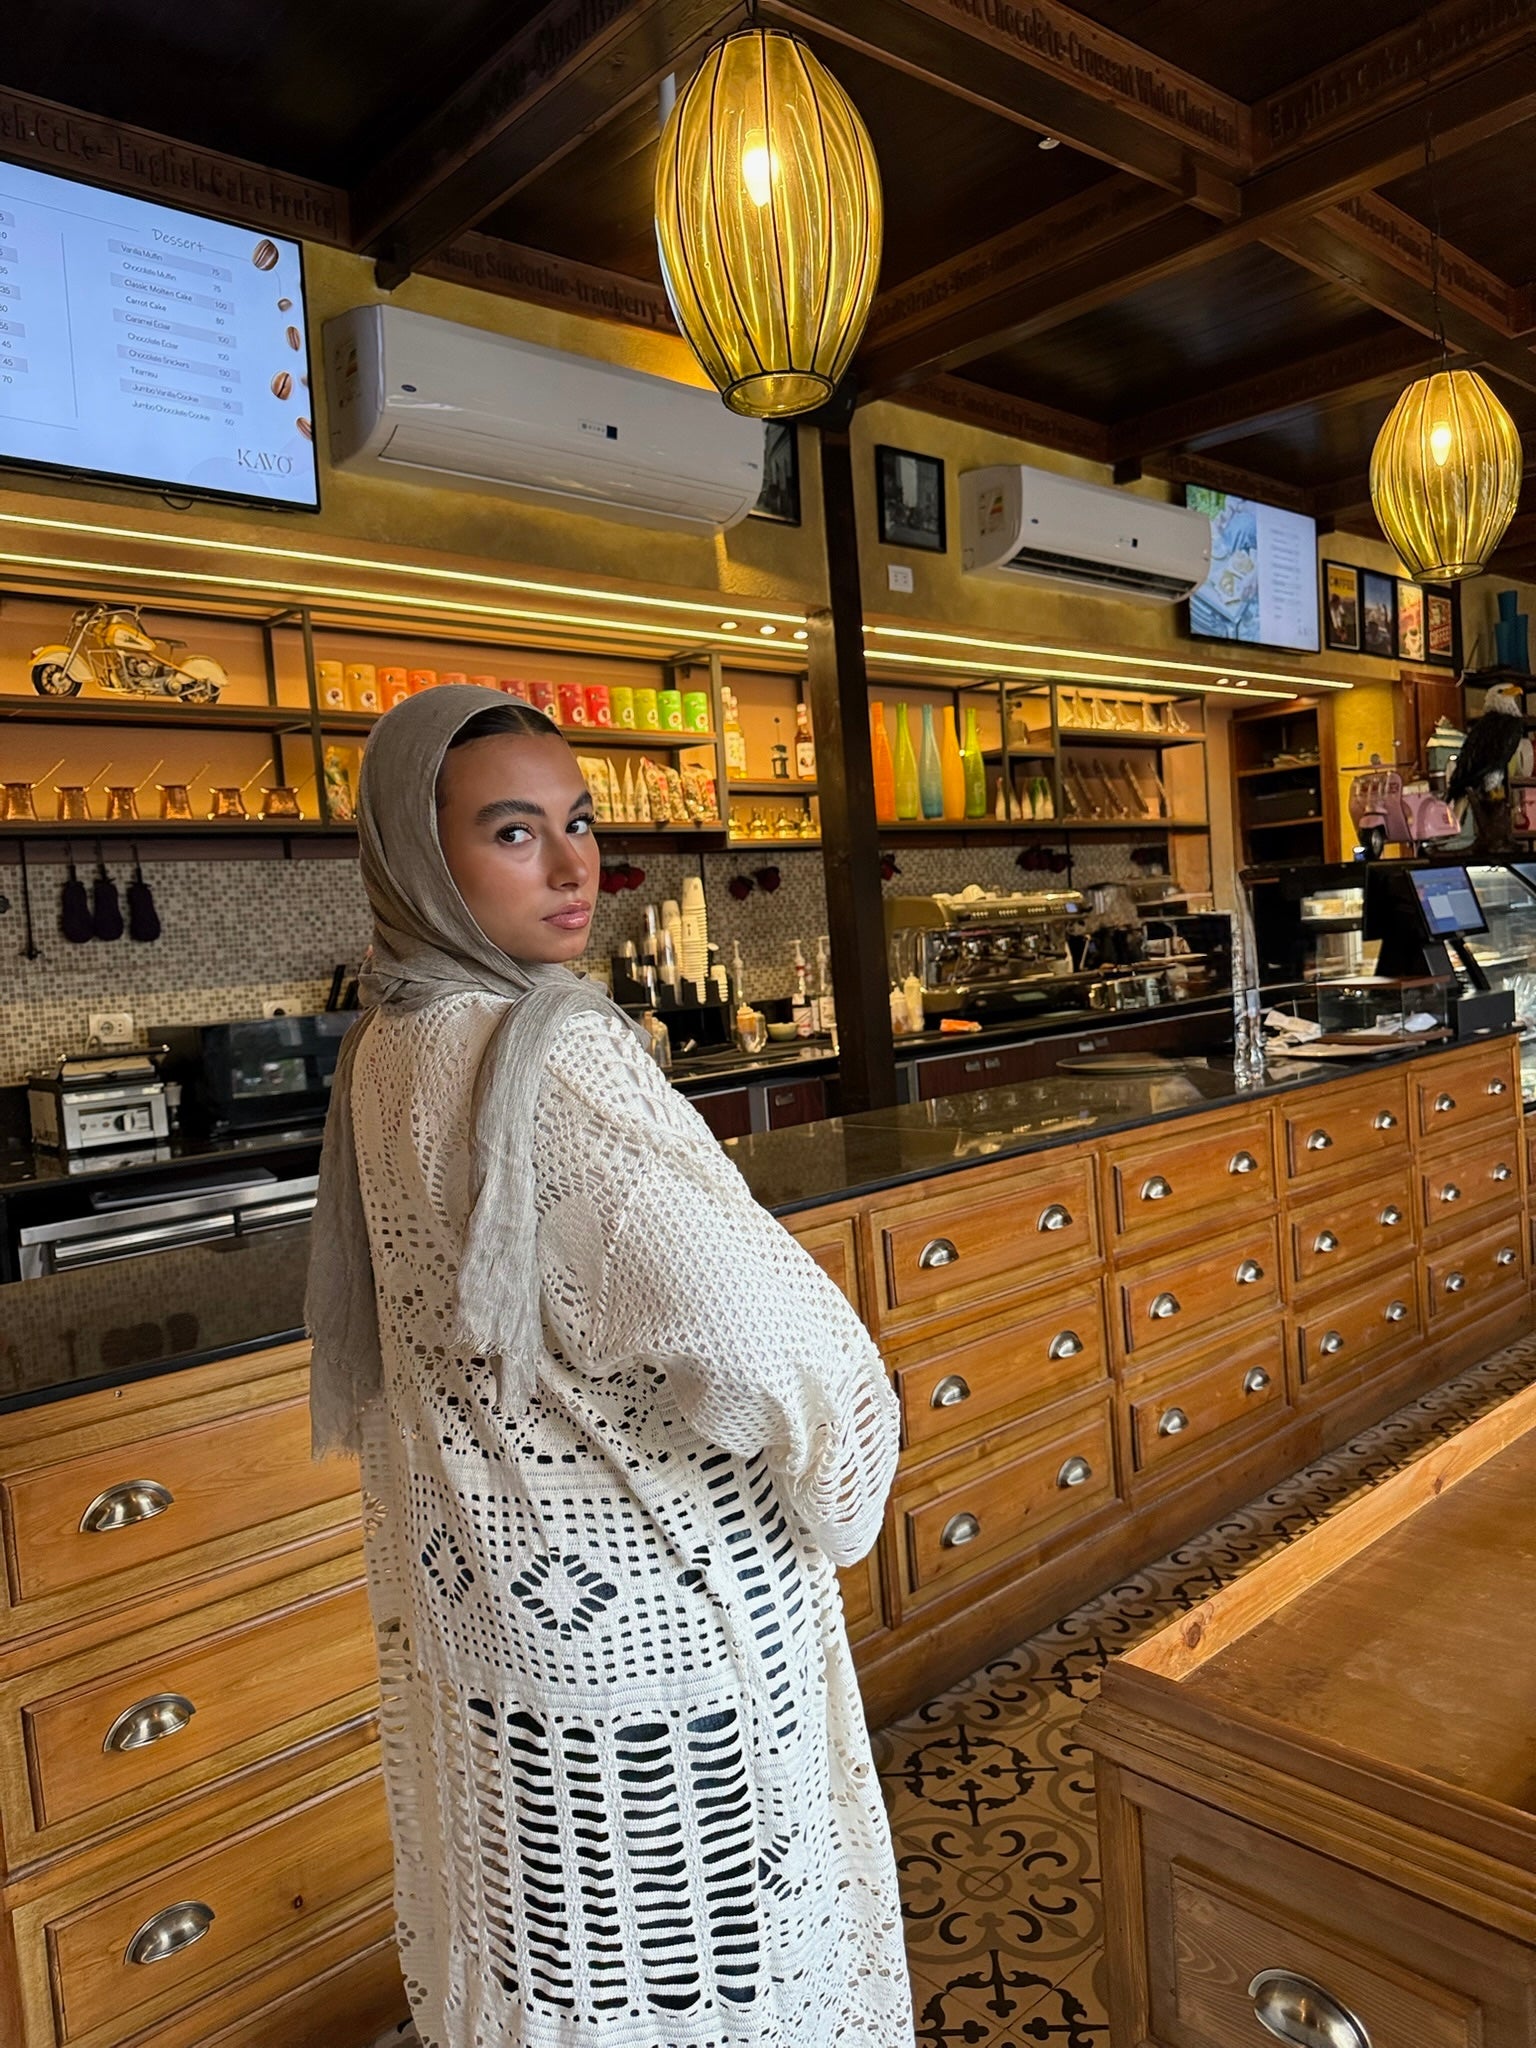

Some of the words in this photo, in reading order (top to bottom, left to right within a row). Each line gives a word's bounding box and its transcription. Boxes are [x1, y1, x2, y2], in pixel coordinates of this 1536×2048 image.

[152, 228, 204, 252] Dessert
[121, 244, 142, 257] Vanilla
[142, 249, 162, 261] Muffin
[123, 262, 156, 276] Chocolate
[156, 269, 177, 281] Muffin
[124, 279, 148, 292] Classic
[149, 284, 175, 298] Molten
[175, 291, 193, 302] Cake
[125, 296, 148, 309] Carrot
[149, 301, 167, 313] Cake
[125, 313, 153, 328] Caramel
[1, 340, 12, 349] 45
[127, 332, 161, 347] Chocolate
[3, 358, 13, 367] 45
[128, 349, 161, 363] Chocolate
[162, 356, 190, 369] Snickers
[2, 375, 13, 384] 70
[132, 384, 155, 395] Jumbo
[132, 401, 154, 412] Jumbo
[237, 448, 292, 474] KAVO
